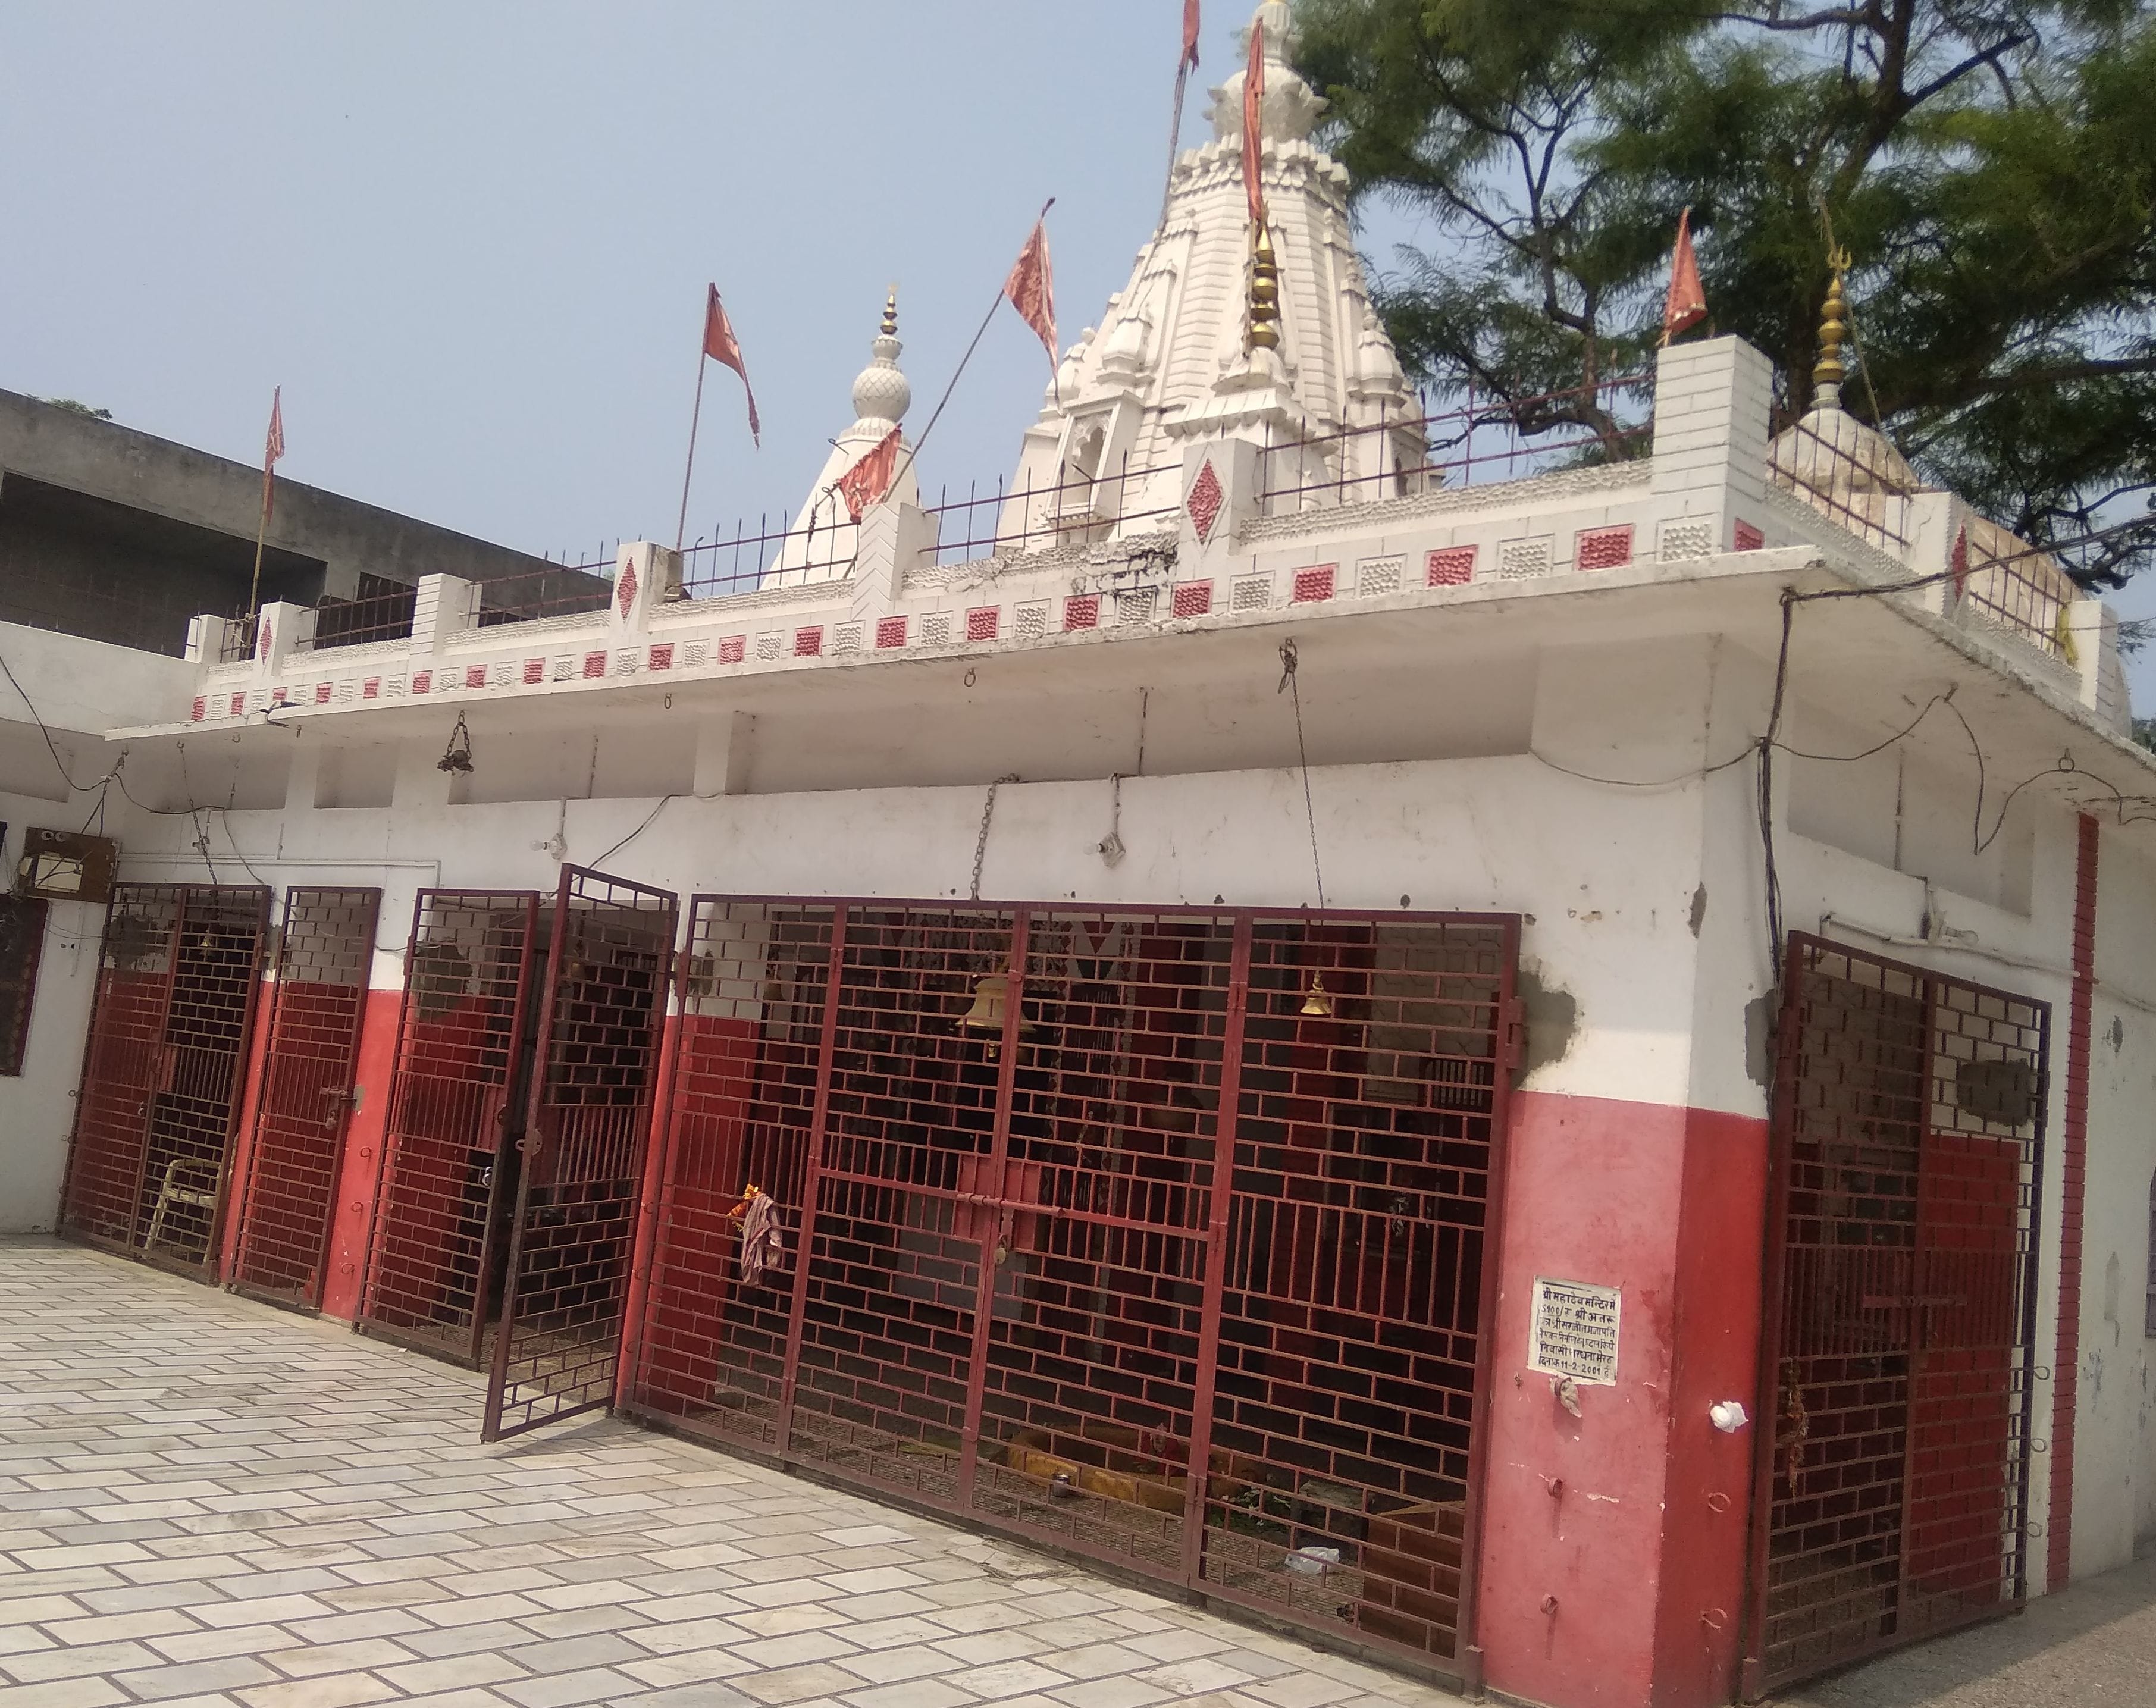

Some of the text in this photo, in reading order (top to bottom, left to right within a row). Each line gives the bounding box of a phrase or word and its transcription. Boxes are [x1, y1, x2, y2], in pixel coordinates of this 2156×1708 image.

[1553, 1290, 1584, 1305] महादेव
[1585, 1295, 1609, 1310] मन्दिर
[1575, 1307, 1588, 1320] श्री
[1540, 1340, 1569, 1356] निवासी
